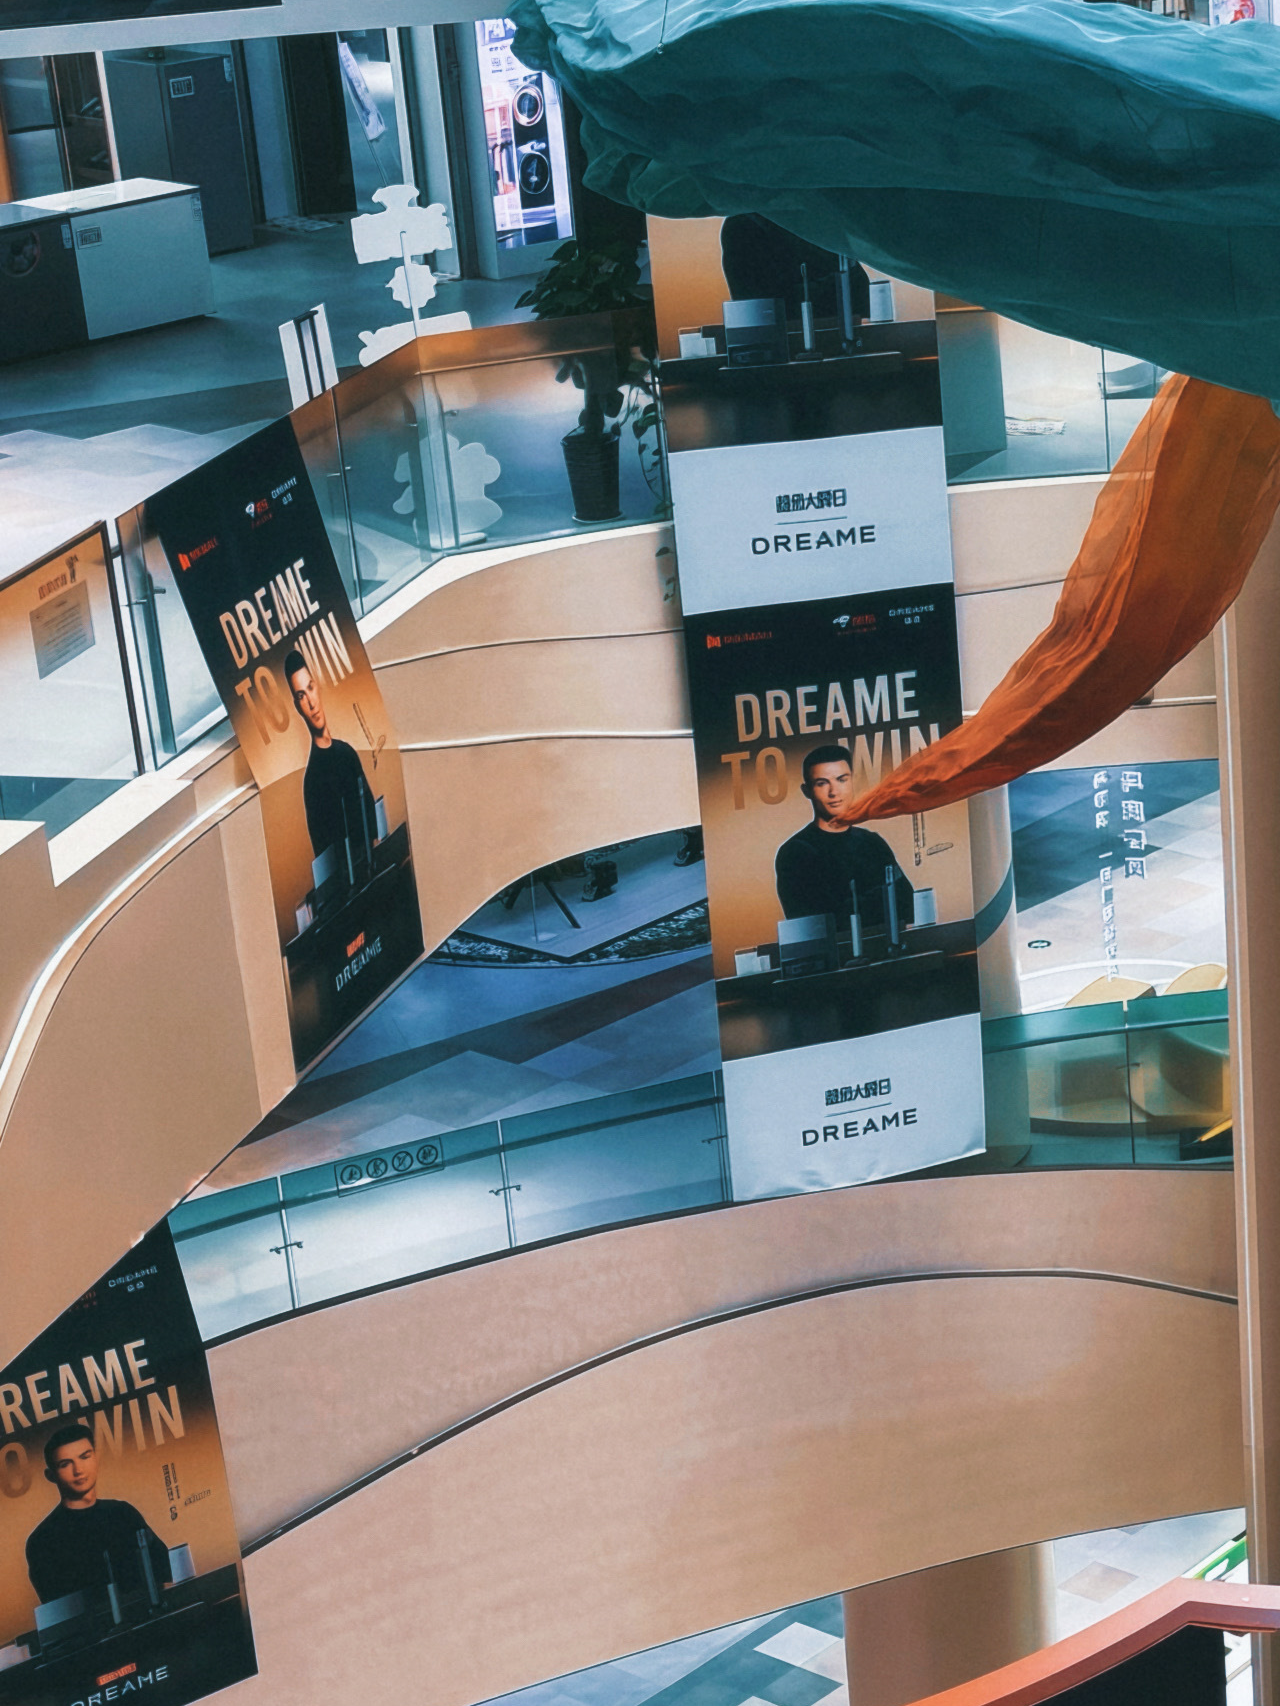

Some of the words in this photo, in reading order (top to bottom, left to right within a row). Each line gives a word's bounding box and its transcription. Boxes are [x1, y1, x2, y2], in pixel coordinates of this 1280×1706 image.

[750, 524, 878, 556] DREAME
[219, 555, 320, 670] DREAME
[293, 611, 355, 690] WIN
[234, 664, 292, 747] TO
[734, 670, 921, 744] DREAME
[720, 749, 790, 811] TO
[801, 1107, 918, 1147] DREAME
[0, 1337, 157, 1440] REAME
[84, 1384, 184, 1459] WIN
[0, 1440, 32, 1500] O
